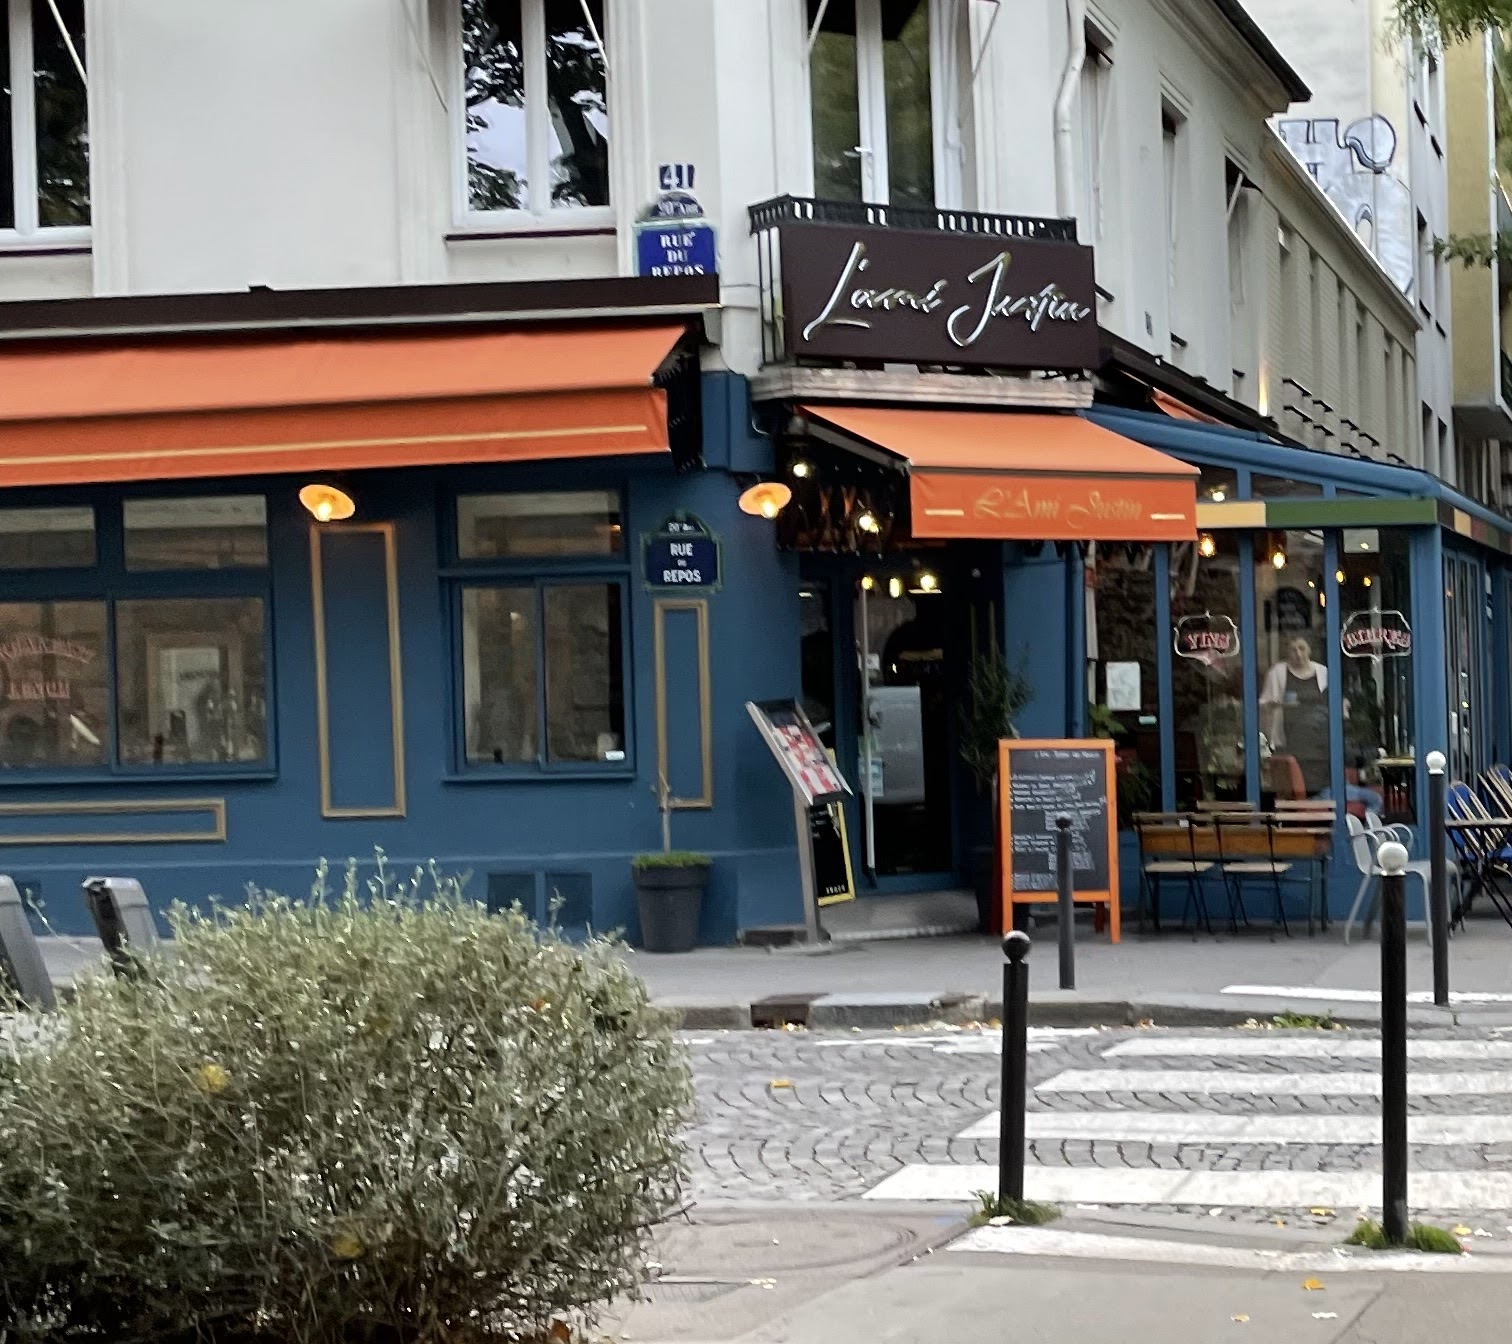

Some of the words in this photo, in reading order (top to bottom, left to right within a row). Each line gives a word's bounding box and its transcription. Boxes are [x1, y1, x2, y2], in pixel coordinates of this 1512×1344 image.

[660, 233, 694, 248] RUE
[666, 249, 688, 263] DU
[947, 250, 1091, 347] Justin
[669, 542, 694, 557] RUE
[663, 569, 702, 583] REPOS
[1186, 631, 1230, 650] VINS
